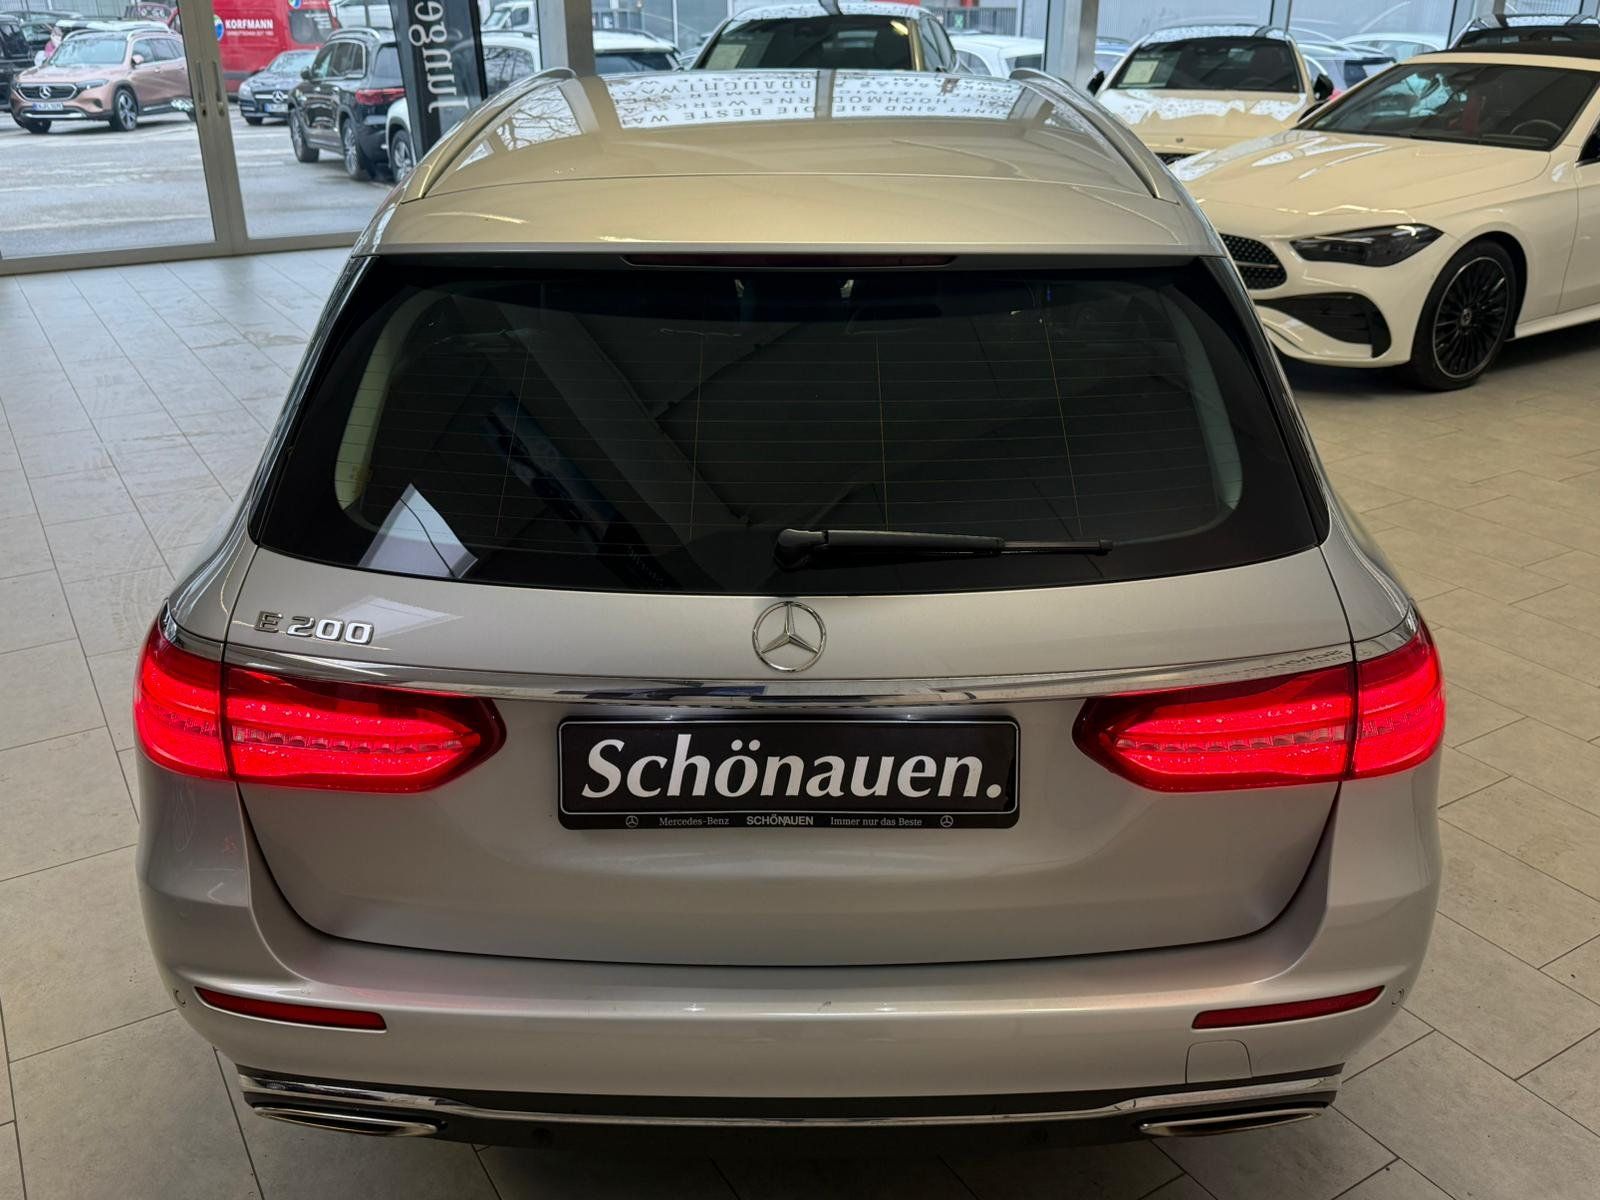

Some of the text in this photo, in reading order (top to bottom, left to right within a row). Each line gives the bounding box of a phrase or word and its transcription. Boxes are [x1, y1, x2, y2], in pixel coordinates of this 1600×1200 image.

[225, 18, 273, 30] KORFMANN
[254, 610, 375, 645] E 200
[581, 733, 1002, 798] Schönauen.
[659, 814, 923, 827] Mercedes-Benz SCHÖNAUEN Immer nur das Beste
